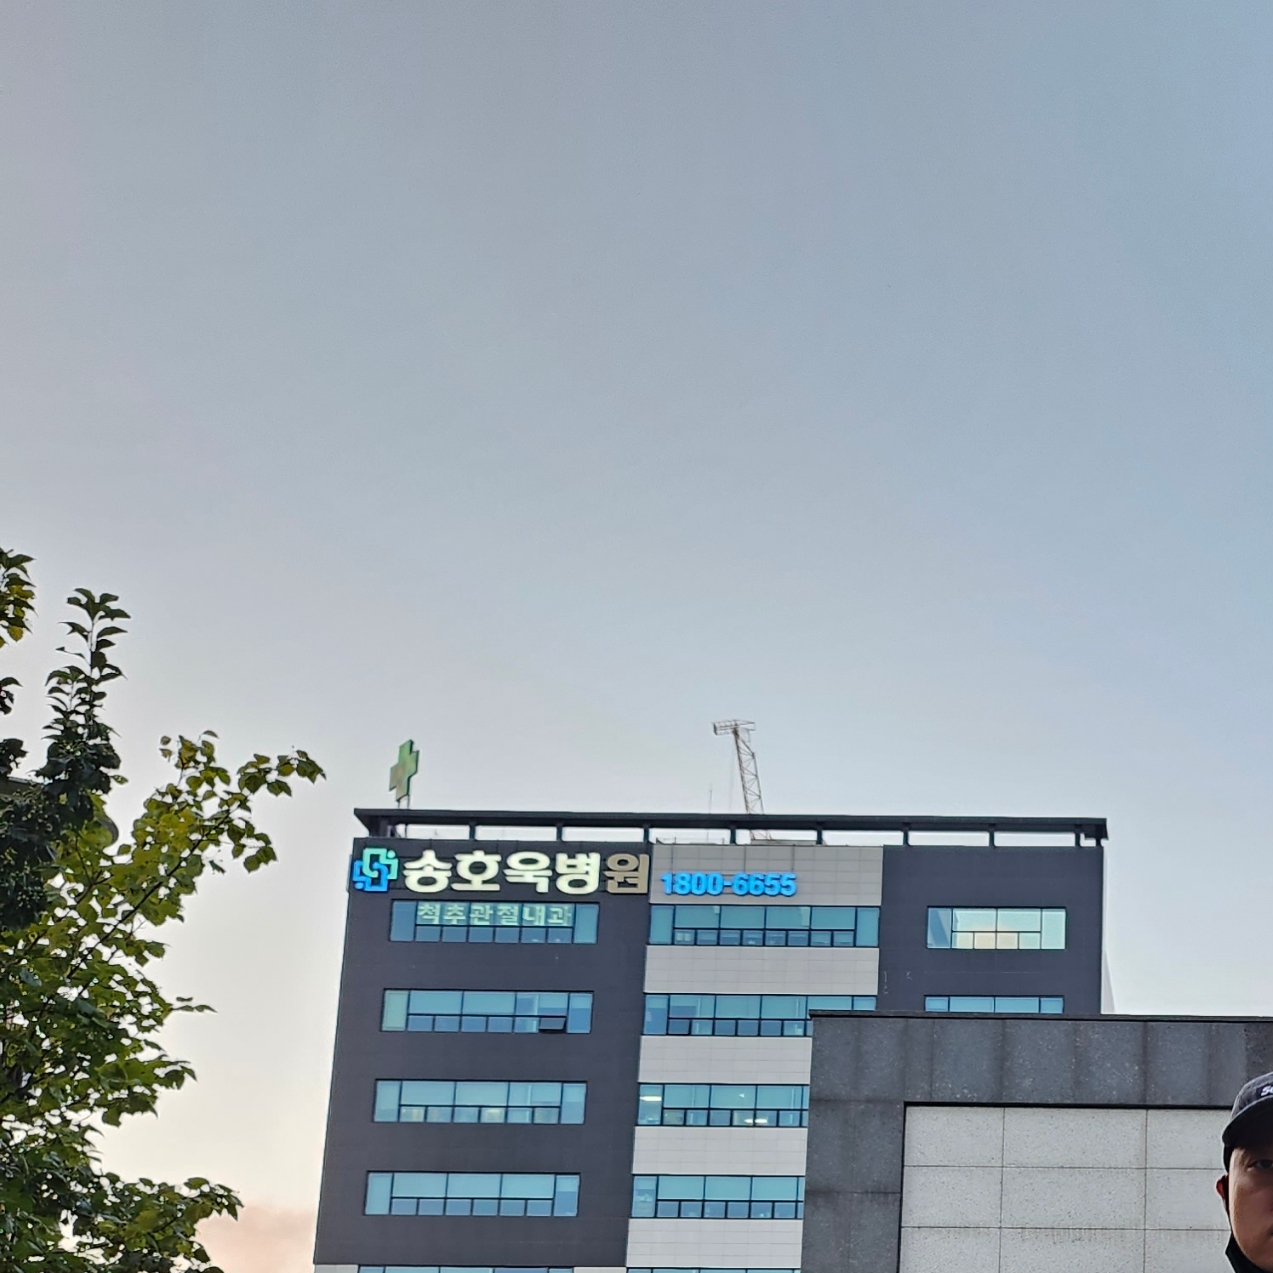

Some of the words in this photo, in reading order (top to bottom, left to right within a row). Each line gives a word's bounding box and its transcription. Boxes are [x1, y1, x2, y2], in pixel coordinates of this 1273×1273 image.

[403, 850, 648, 894] 송호욱병원
[661, 873, 796, 897] 1800-6655
[417, 903, 571, 926] 척추관절내과
